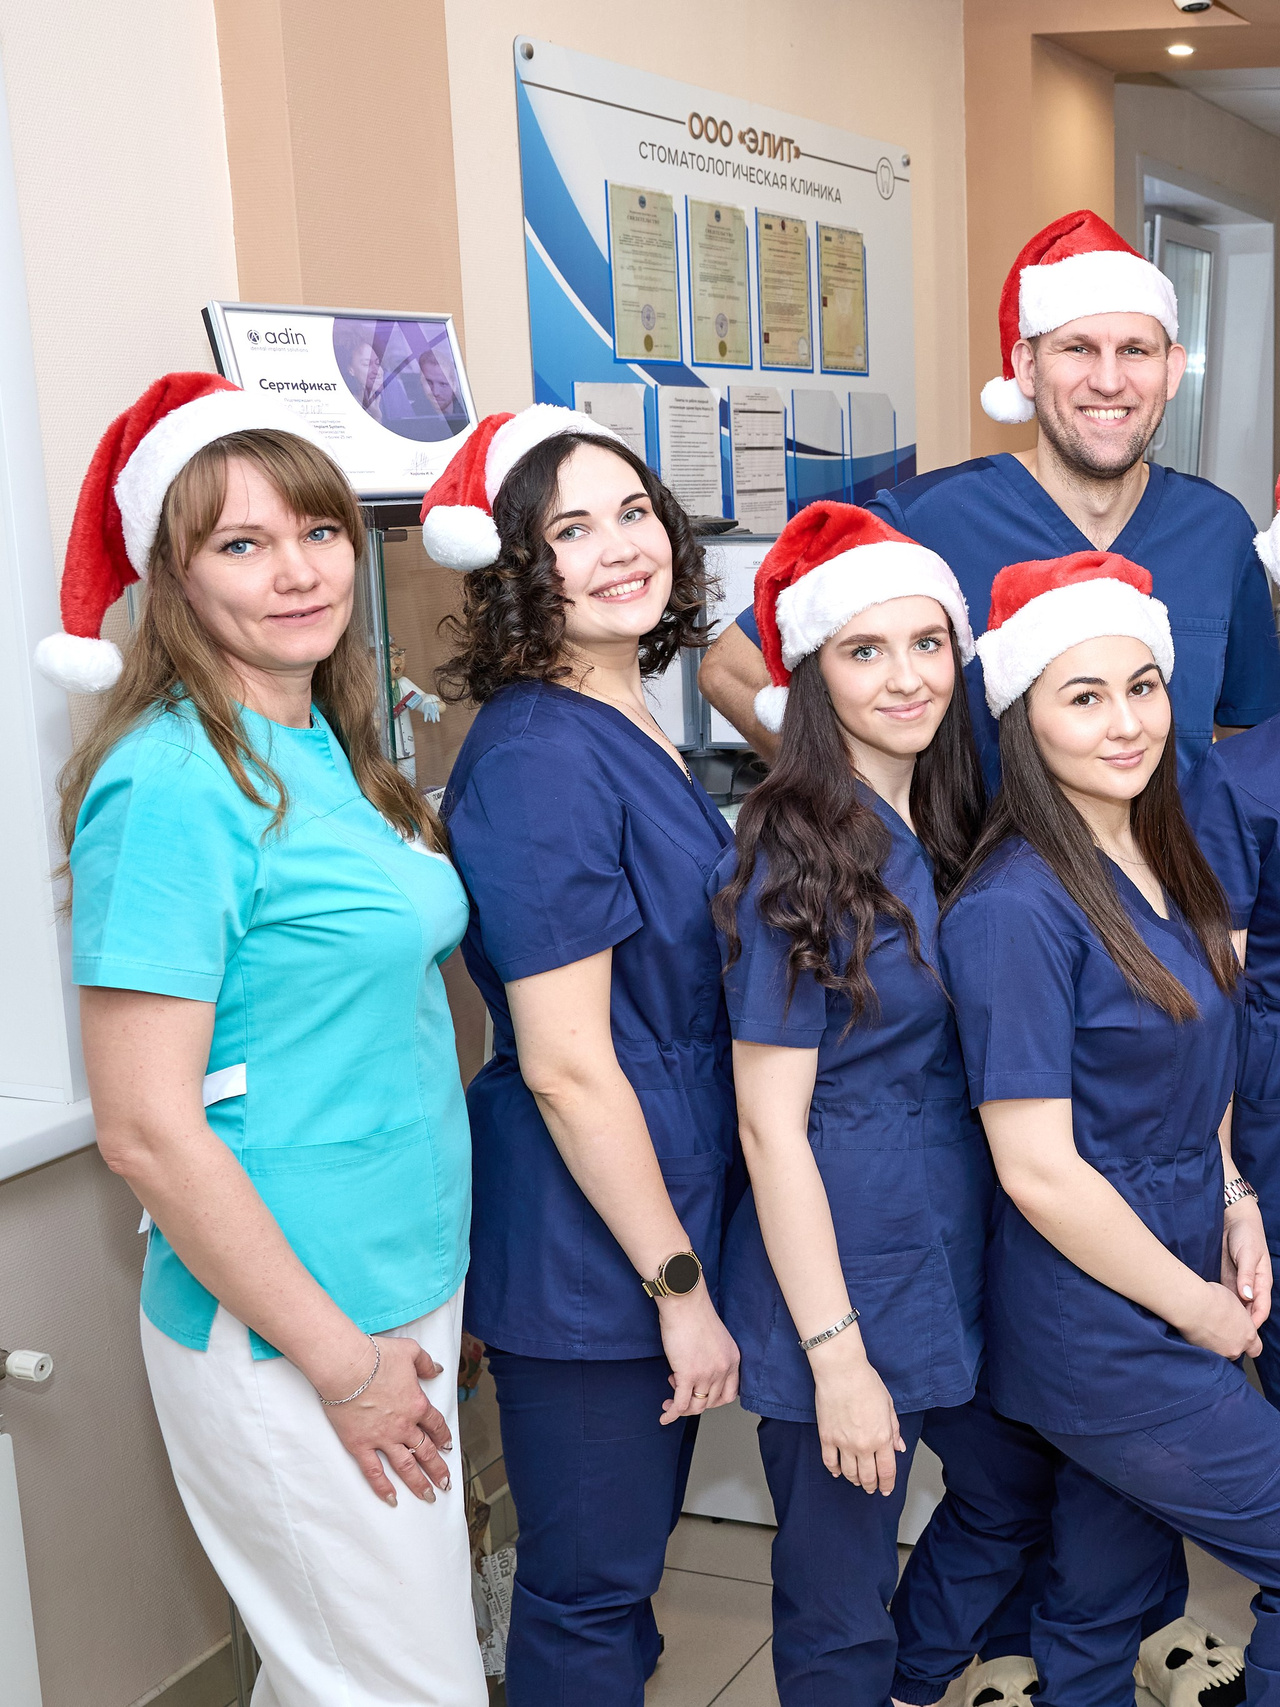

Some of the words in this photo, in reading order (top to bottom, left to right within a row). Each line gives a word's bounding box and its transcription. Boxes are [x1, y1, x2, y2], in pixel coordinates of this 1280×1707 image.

[688, 112, 733, 147] ООО
[737, 127, 801, 163] «ЭЛИТ»
[638, 141, 787, 190] СТОМАТОЛОГИЧЕСКАЯ
[790, 176, 842, 204] КЛИНИКА
[265, 328, 307, 345] adin
[259, 378, 337, 394] Сертификат
